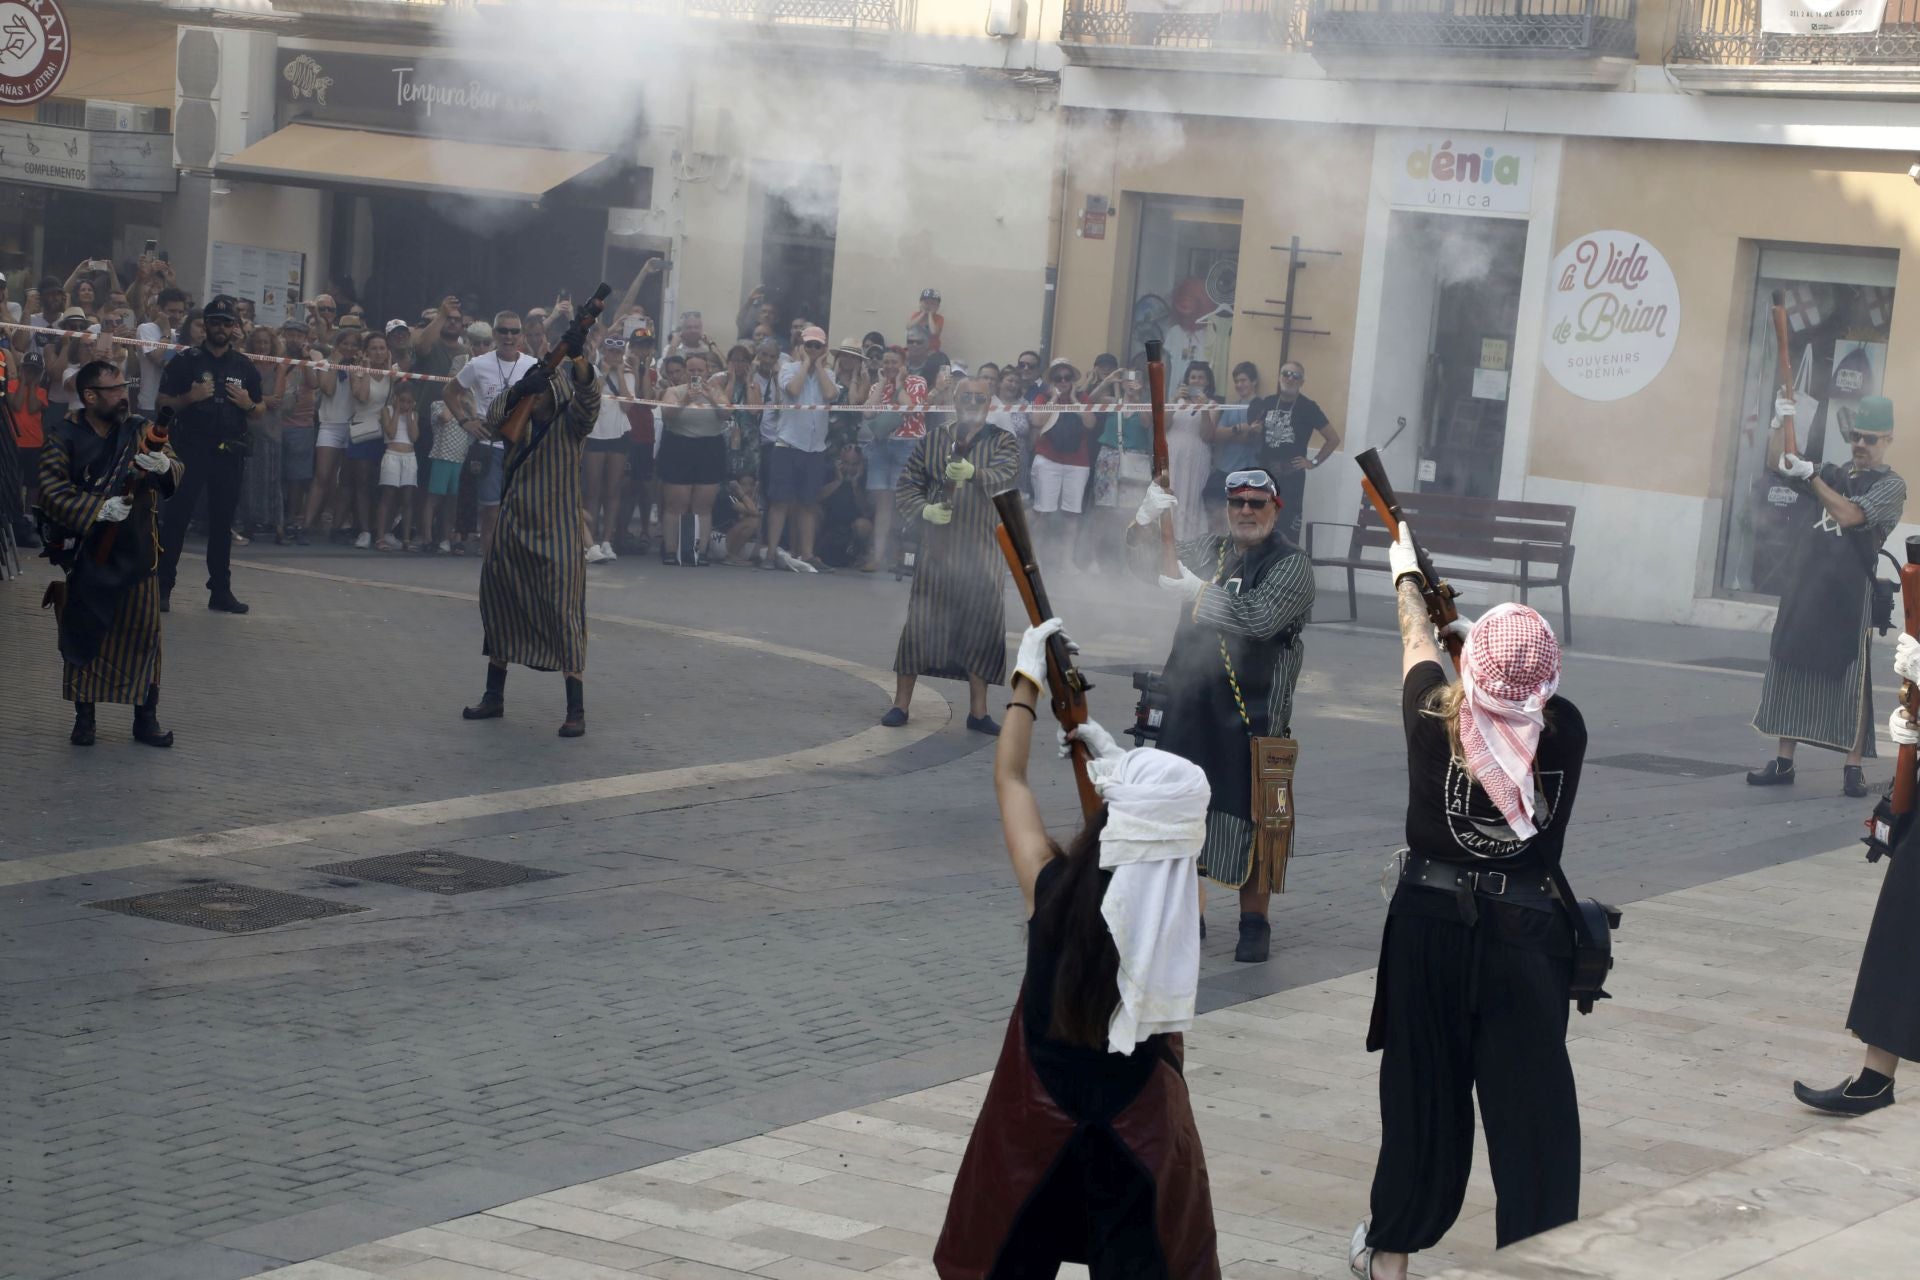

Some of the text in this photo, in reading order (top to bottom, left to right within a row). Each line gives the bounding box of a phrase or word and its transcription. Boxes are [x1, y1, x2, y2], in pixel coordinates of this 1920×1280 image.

[22, 0, 62, 51] RAN
[1835, 9, 1863, 17] AGOSTO
[24, 83, 31, 94] Y
[392, 68, 466, 117] Tempura
[24, 161, 86, 181] COMPLEMENTOS
[1406, 139, 1520, 186] dénia
[1427, 188, 1492, 207] única
[1576, 240, 1649, 290] Vida
[1552, 291, 1668, 344] de Brian
[1567, 352, 1640, 368] SOUVENIRS
